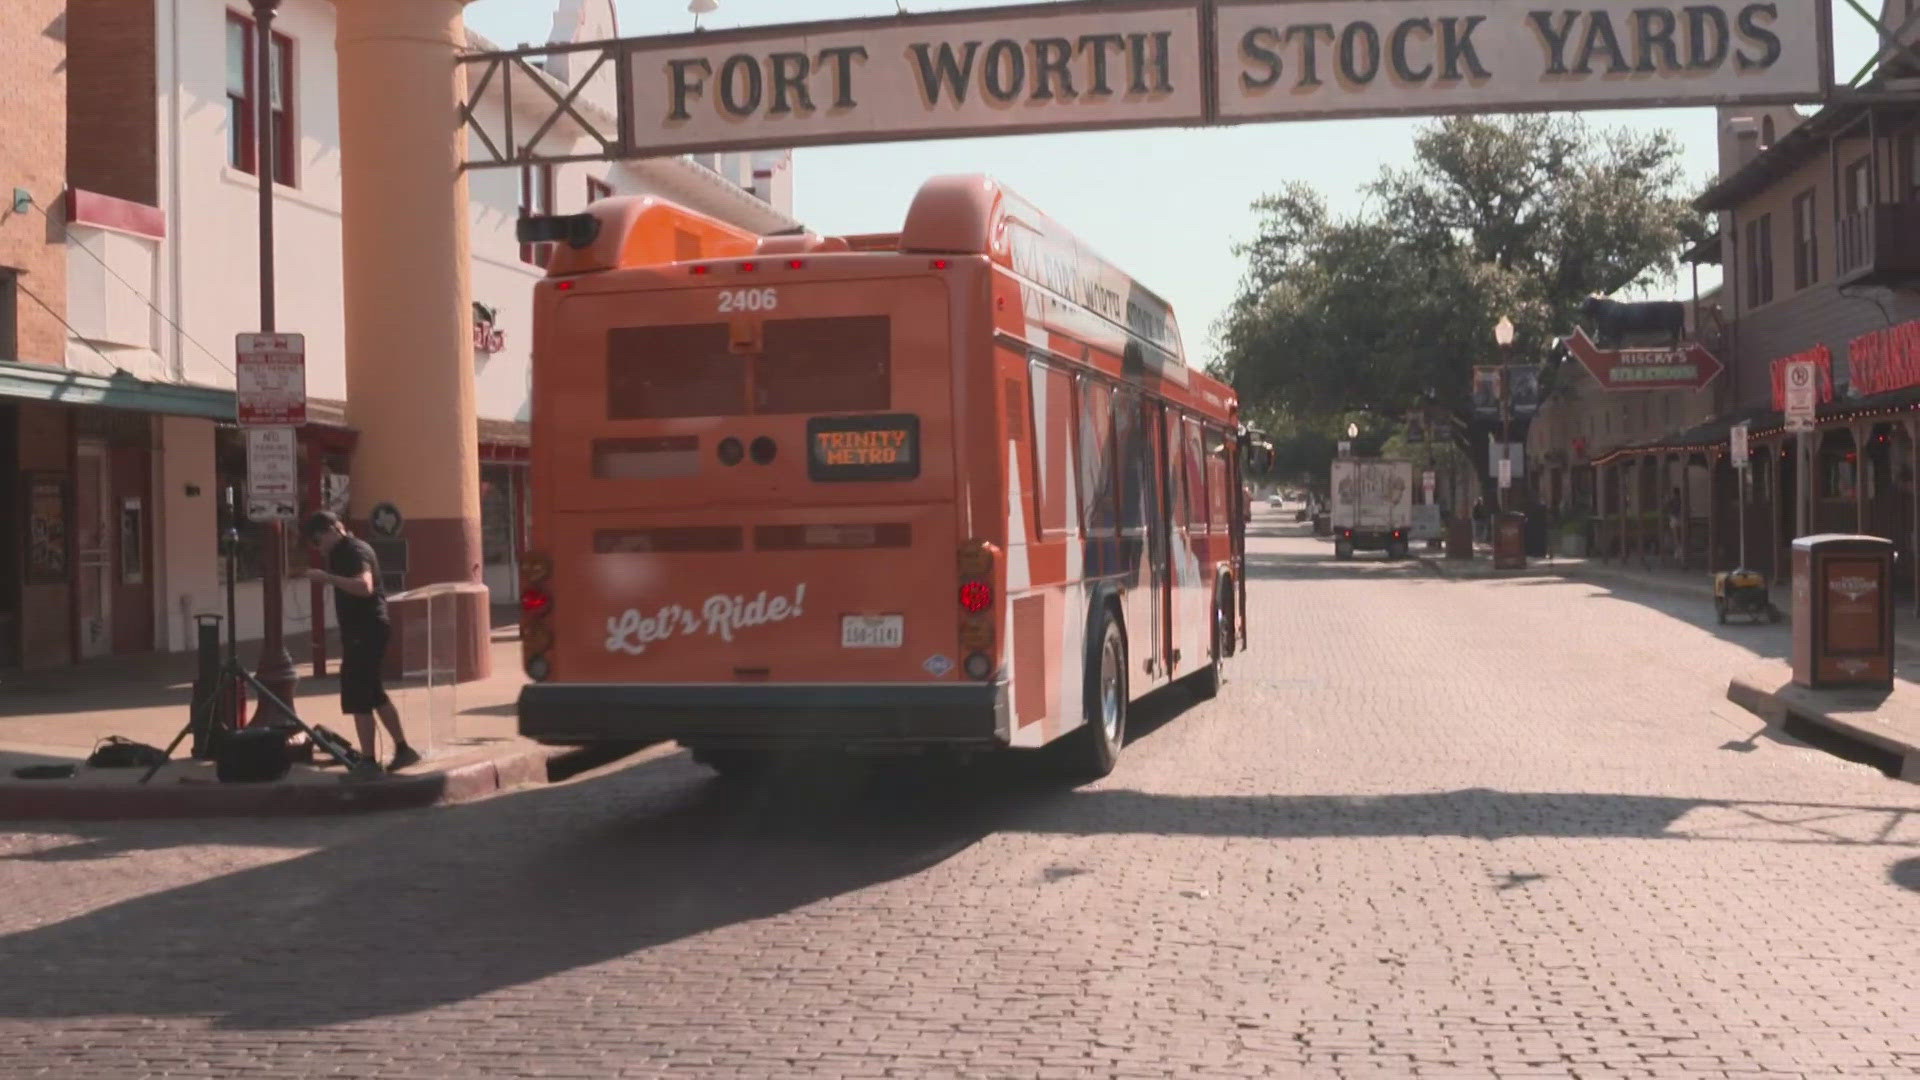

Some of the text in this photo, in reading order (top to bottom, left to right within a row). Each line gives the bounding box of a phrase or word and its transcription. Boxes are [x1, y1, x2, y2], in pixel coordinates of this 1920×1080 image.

[664, 3, 1783, 127] FORT WORTH STOCK YARDS
[717, 288, 778, 312] 2406
[817, 430, 907, 448] TRINITY
[826, 447, 897, 465] METRO
[605, 583, 806, 655] Let's Ride!
